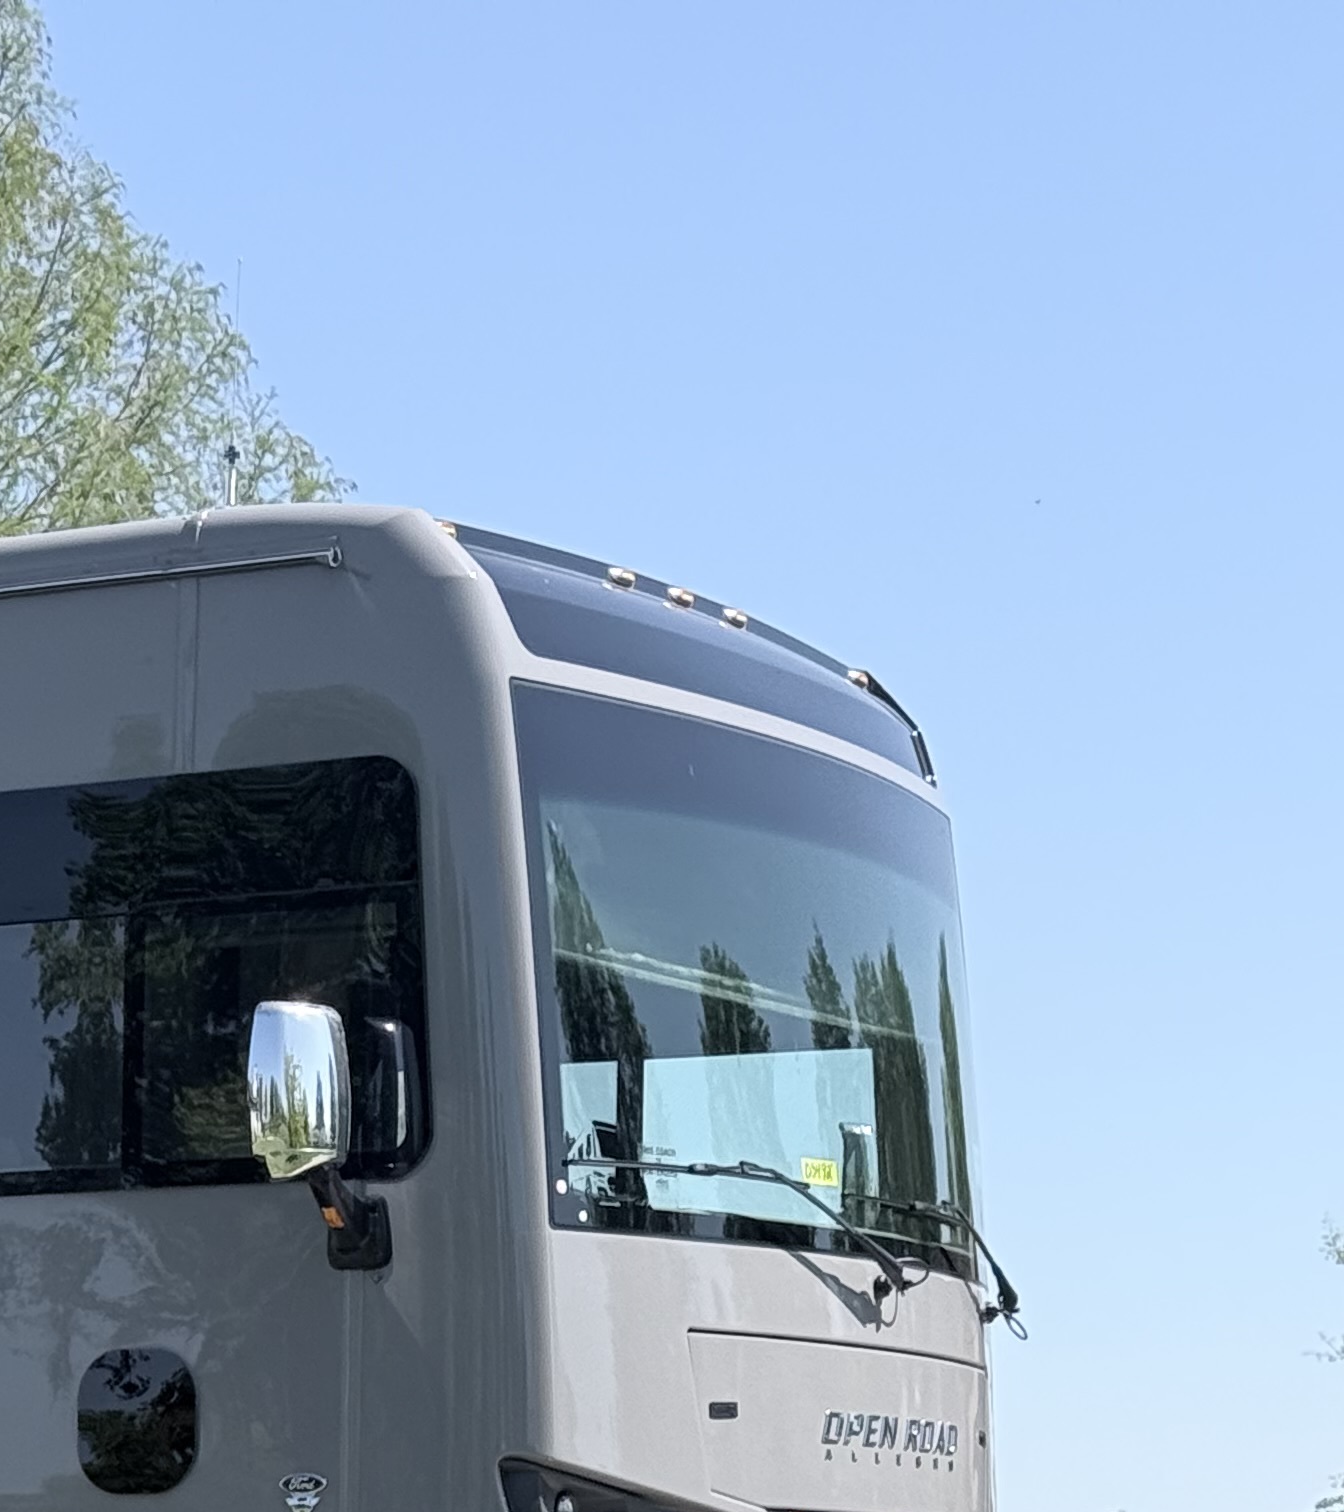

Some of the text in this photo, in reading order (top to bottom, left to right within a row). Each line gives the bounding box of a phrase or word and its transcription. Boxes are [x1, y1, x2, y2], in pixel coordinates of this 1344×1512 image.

[821, 1409, 958, 1456] OPEN ROAD
[288, 1476, 316, 1490] Ford
